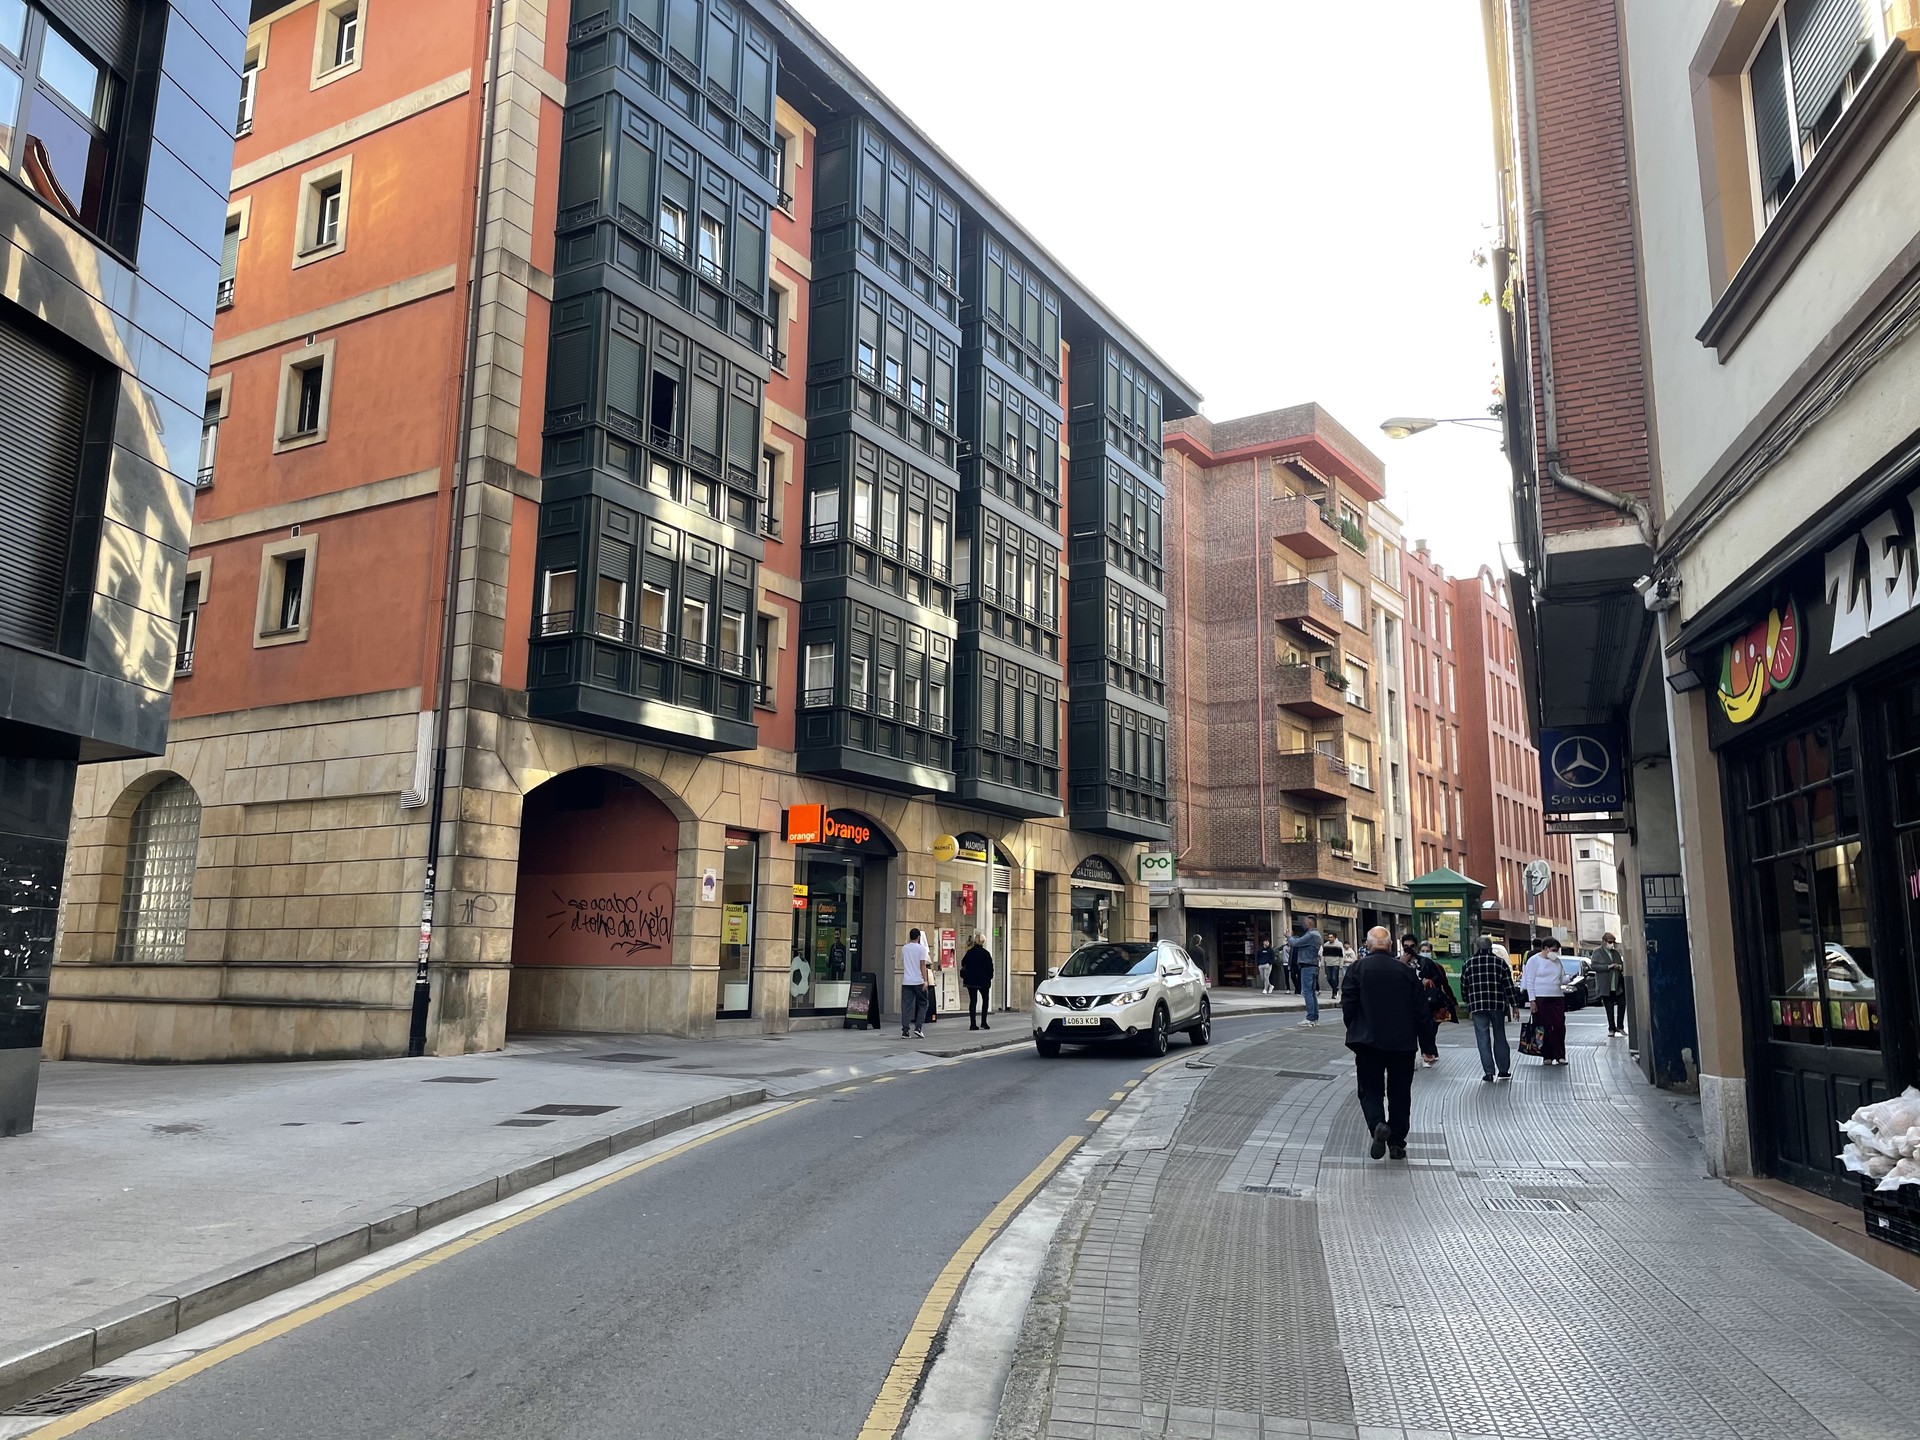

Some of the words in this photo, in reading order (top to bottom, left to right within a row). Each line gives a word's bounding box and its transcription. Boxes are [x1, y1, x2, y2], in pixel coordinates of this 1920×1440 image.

[1824, 486, 1920, 655] ZE
[1551, 793, 1617, 805] Servicio
[825, 818, 870, 844] Orange
[789, 832, 816, 842] orange
[1085, 858, 1103, 869] OPTICA
[1067, 1017, 1084, 1025] 4063
[1085, 1017, 1099, 1025] KCB
